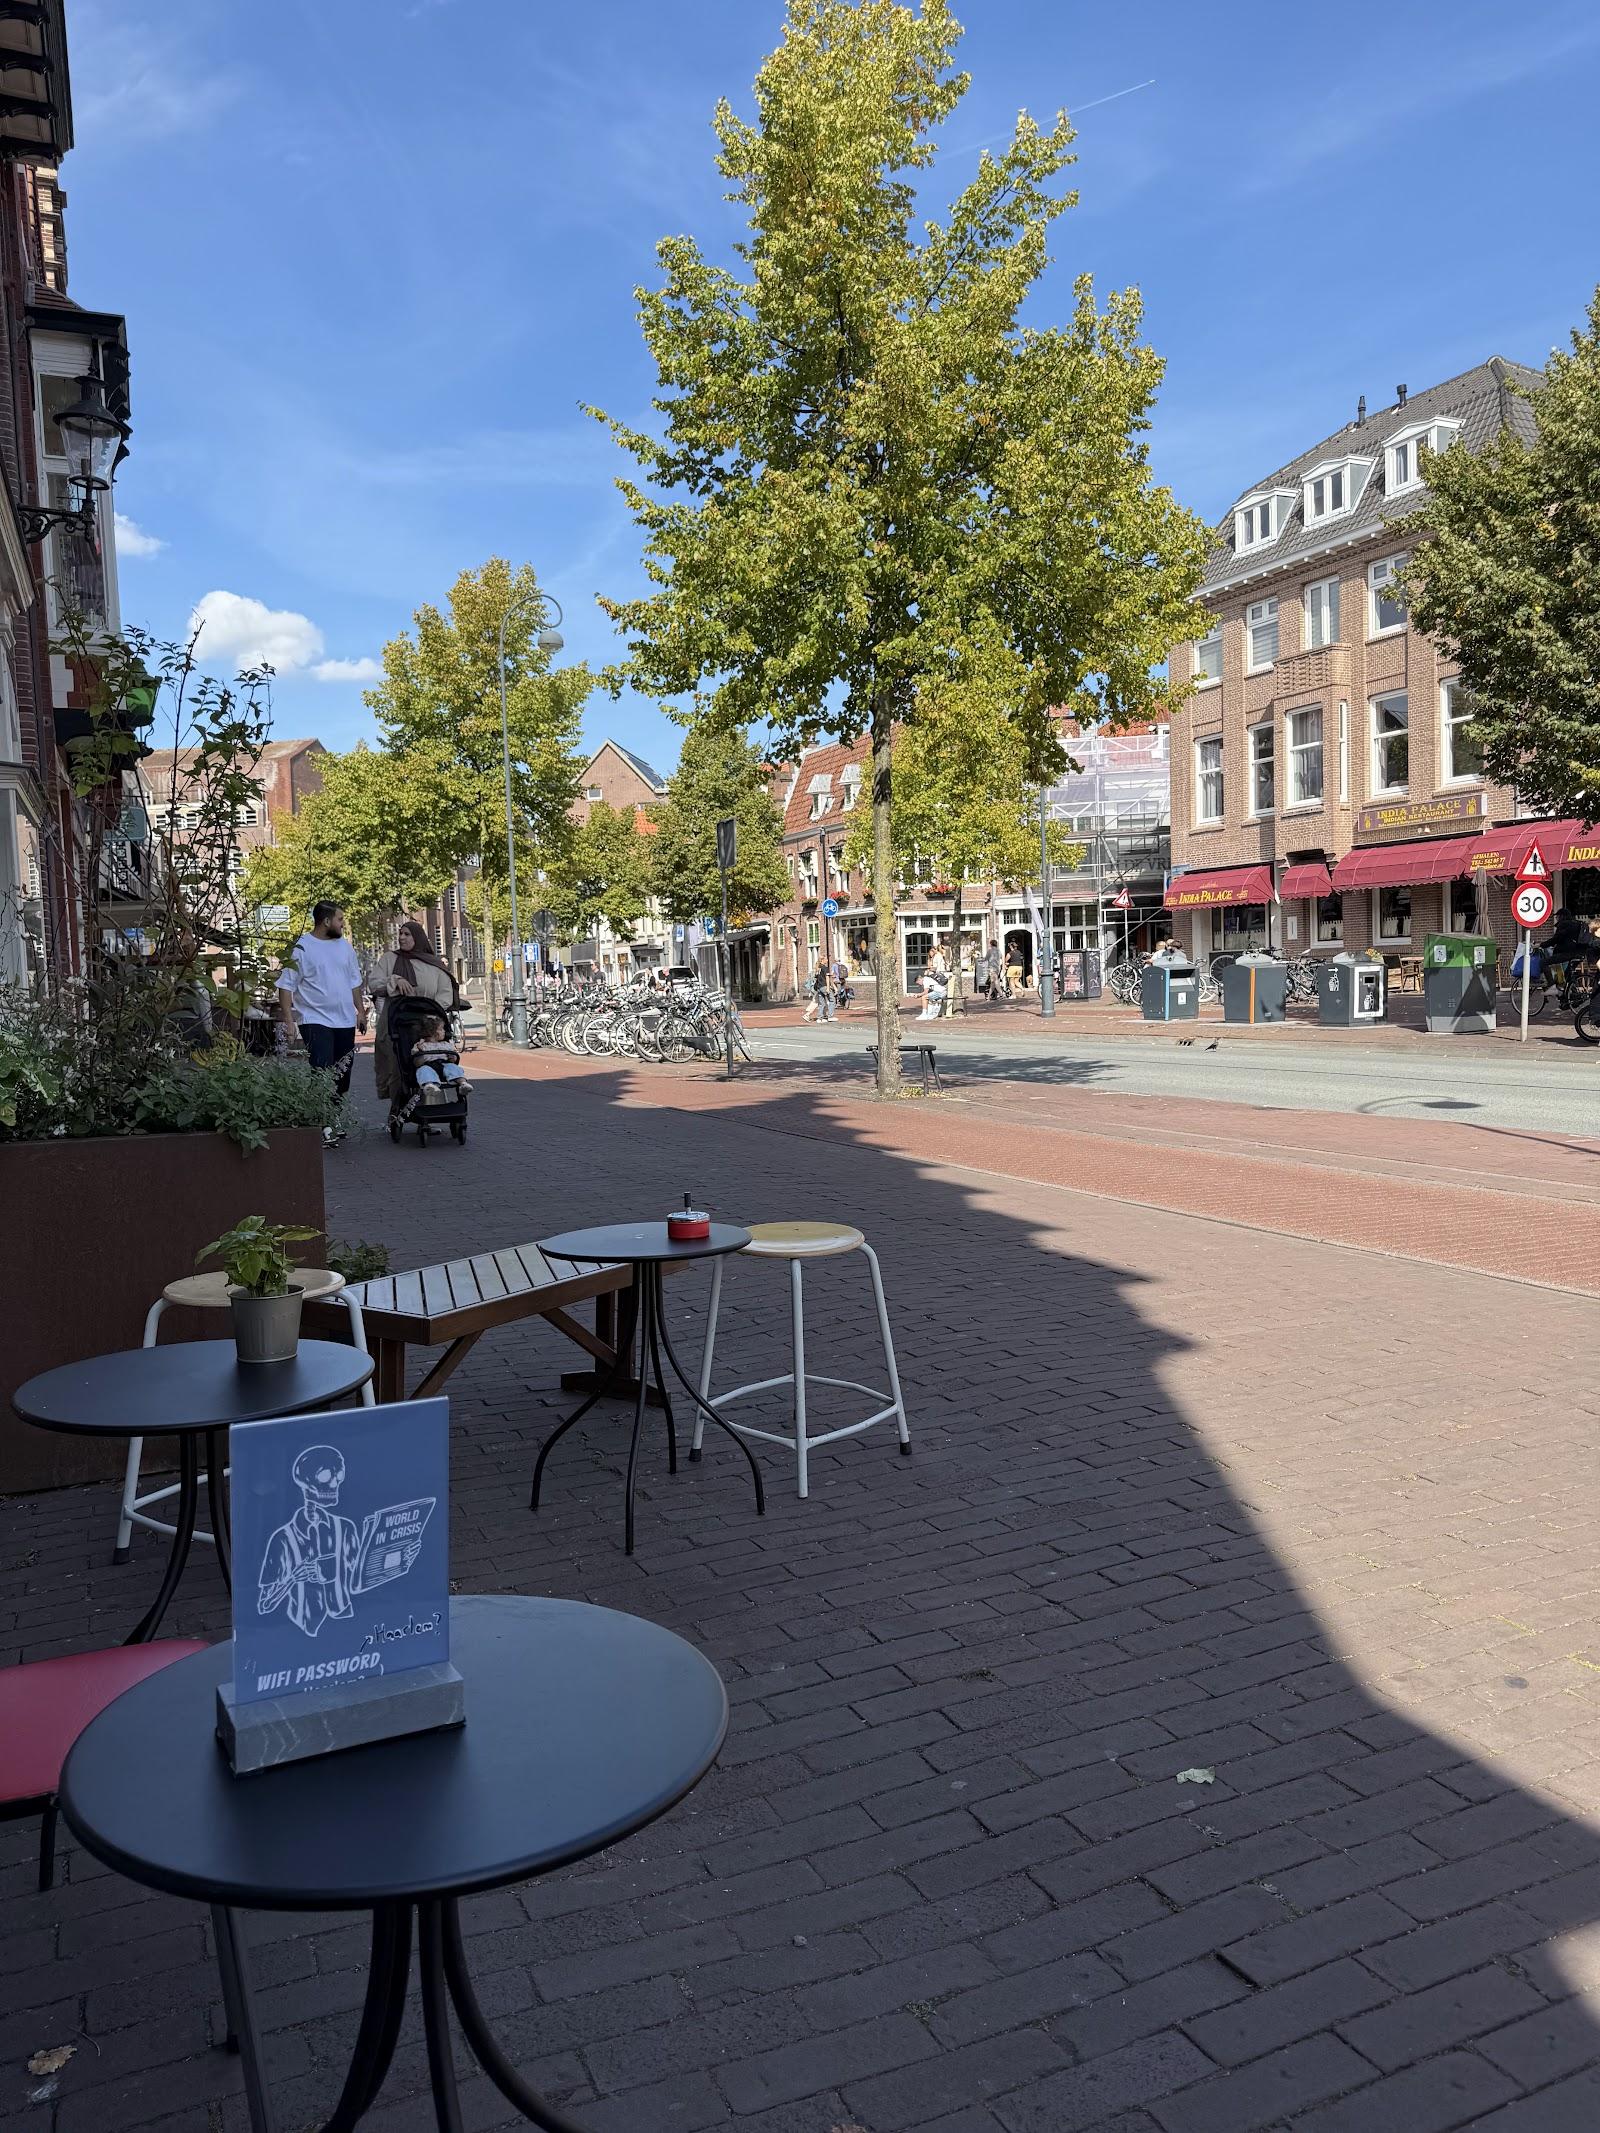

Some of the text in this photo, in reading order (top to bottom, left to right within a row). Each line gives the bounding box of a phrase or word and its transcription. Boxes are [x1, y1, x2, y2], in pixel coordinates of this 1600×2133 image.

[1377, 799, 1461, 819] INDIA PALACE
[1409, 809, 1454, 820] RESTAURANT
[1179, 892, 1200, 904] INDIA
[1200, 890, 1234, 903] PALACE
[1519, 896, 1545, 913] 30
[385, 1509, 420, 1528] WORLD
[375, 1522, 422, 1545] IN CRISIS
[374, 1612, 442, 1644] Haarlem?
[257, 1670, 292, 1692] WIFI
[296, 1652, 381, 1684] PASSWORD
